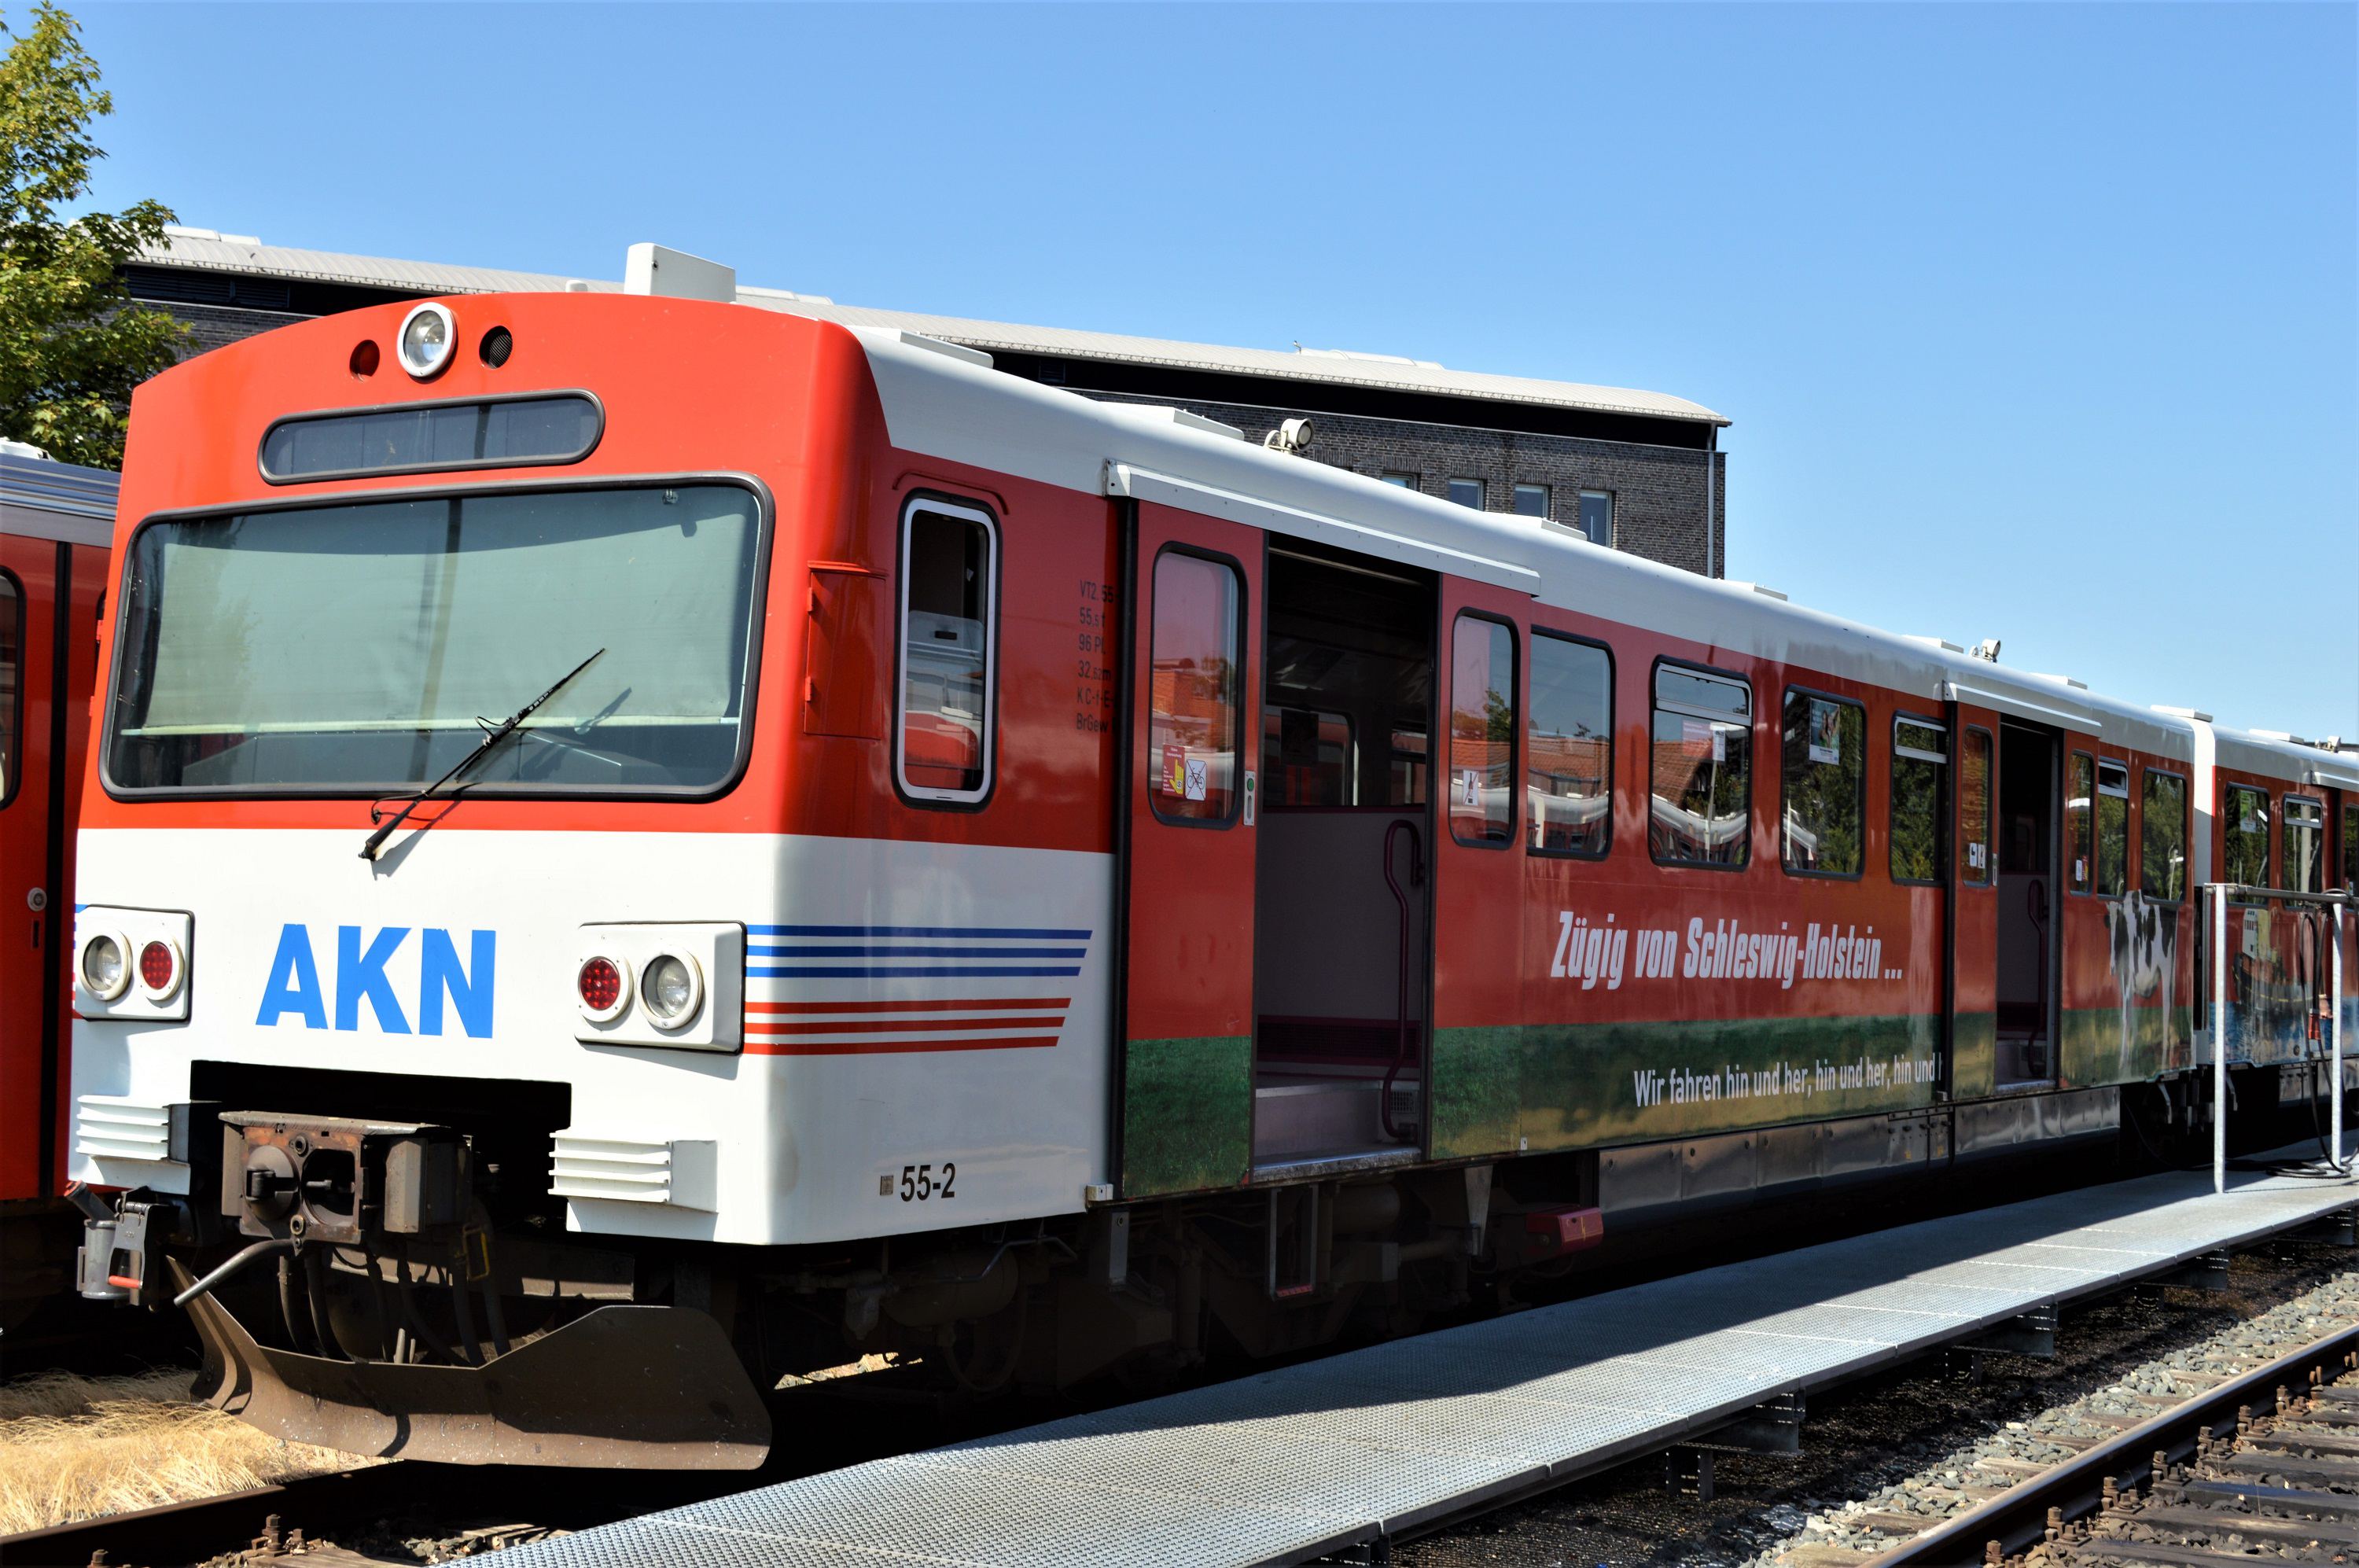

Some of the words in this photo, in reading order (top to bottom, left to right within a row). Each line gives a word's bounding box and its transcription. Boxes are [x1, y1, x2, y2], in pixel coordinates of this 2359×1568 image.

[1079, 632, 1091, 652] 96
[1551, 911, 1628, 990] Zügig
[1635, 929, 1677, 978] von
[1684, 917, 1881, 989] Schleswig-Holstein
[256, 923, 496, 1039] AKN
[1634, 1069, 1665, 1107] Wir
[1669, 1067, 1720, 1104] fahren
[1726, 1064, 1749, 1099] hin
[1754, 1062, 1779, 1097] und
[1784, 1062, 1812, 1098] her,
[1816, 1058, 1835, 1091] hin
[1840, 1056, 1862, 1089] und
[1867, 1056, 1890, 1091] her,
[1893, 1054, 1911, 1084] hin
[1915, 1052, 1935, 1083] und
[900, 1162, 955, 1202] 55-2
